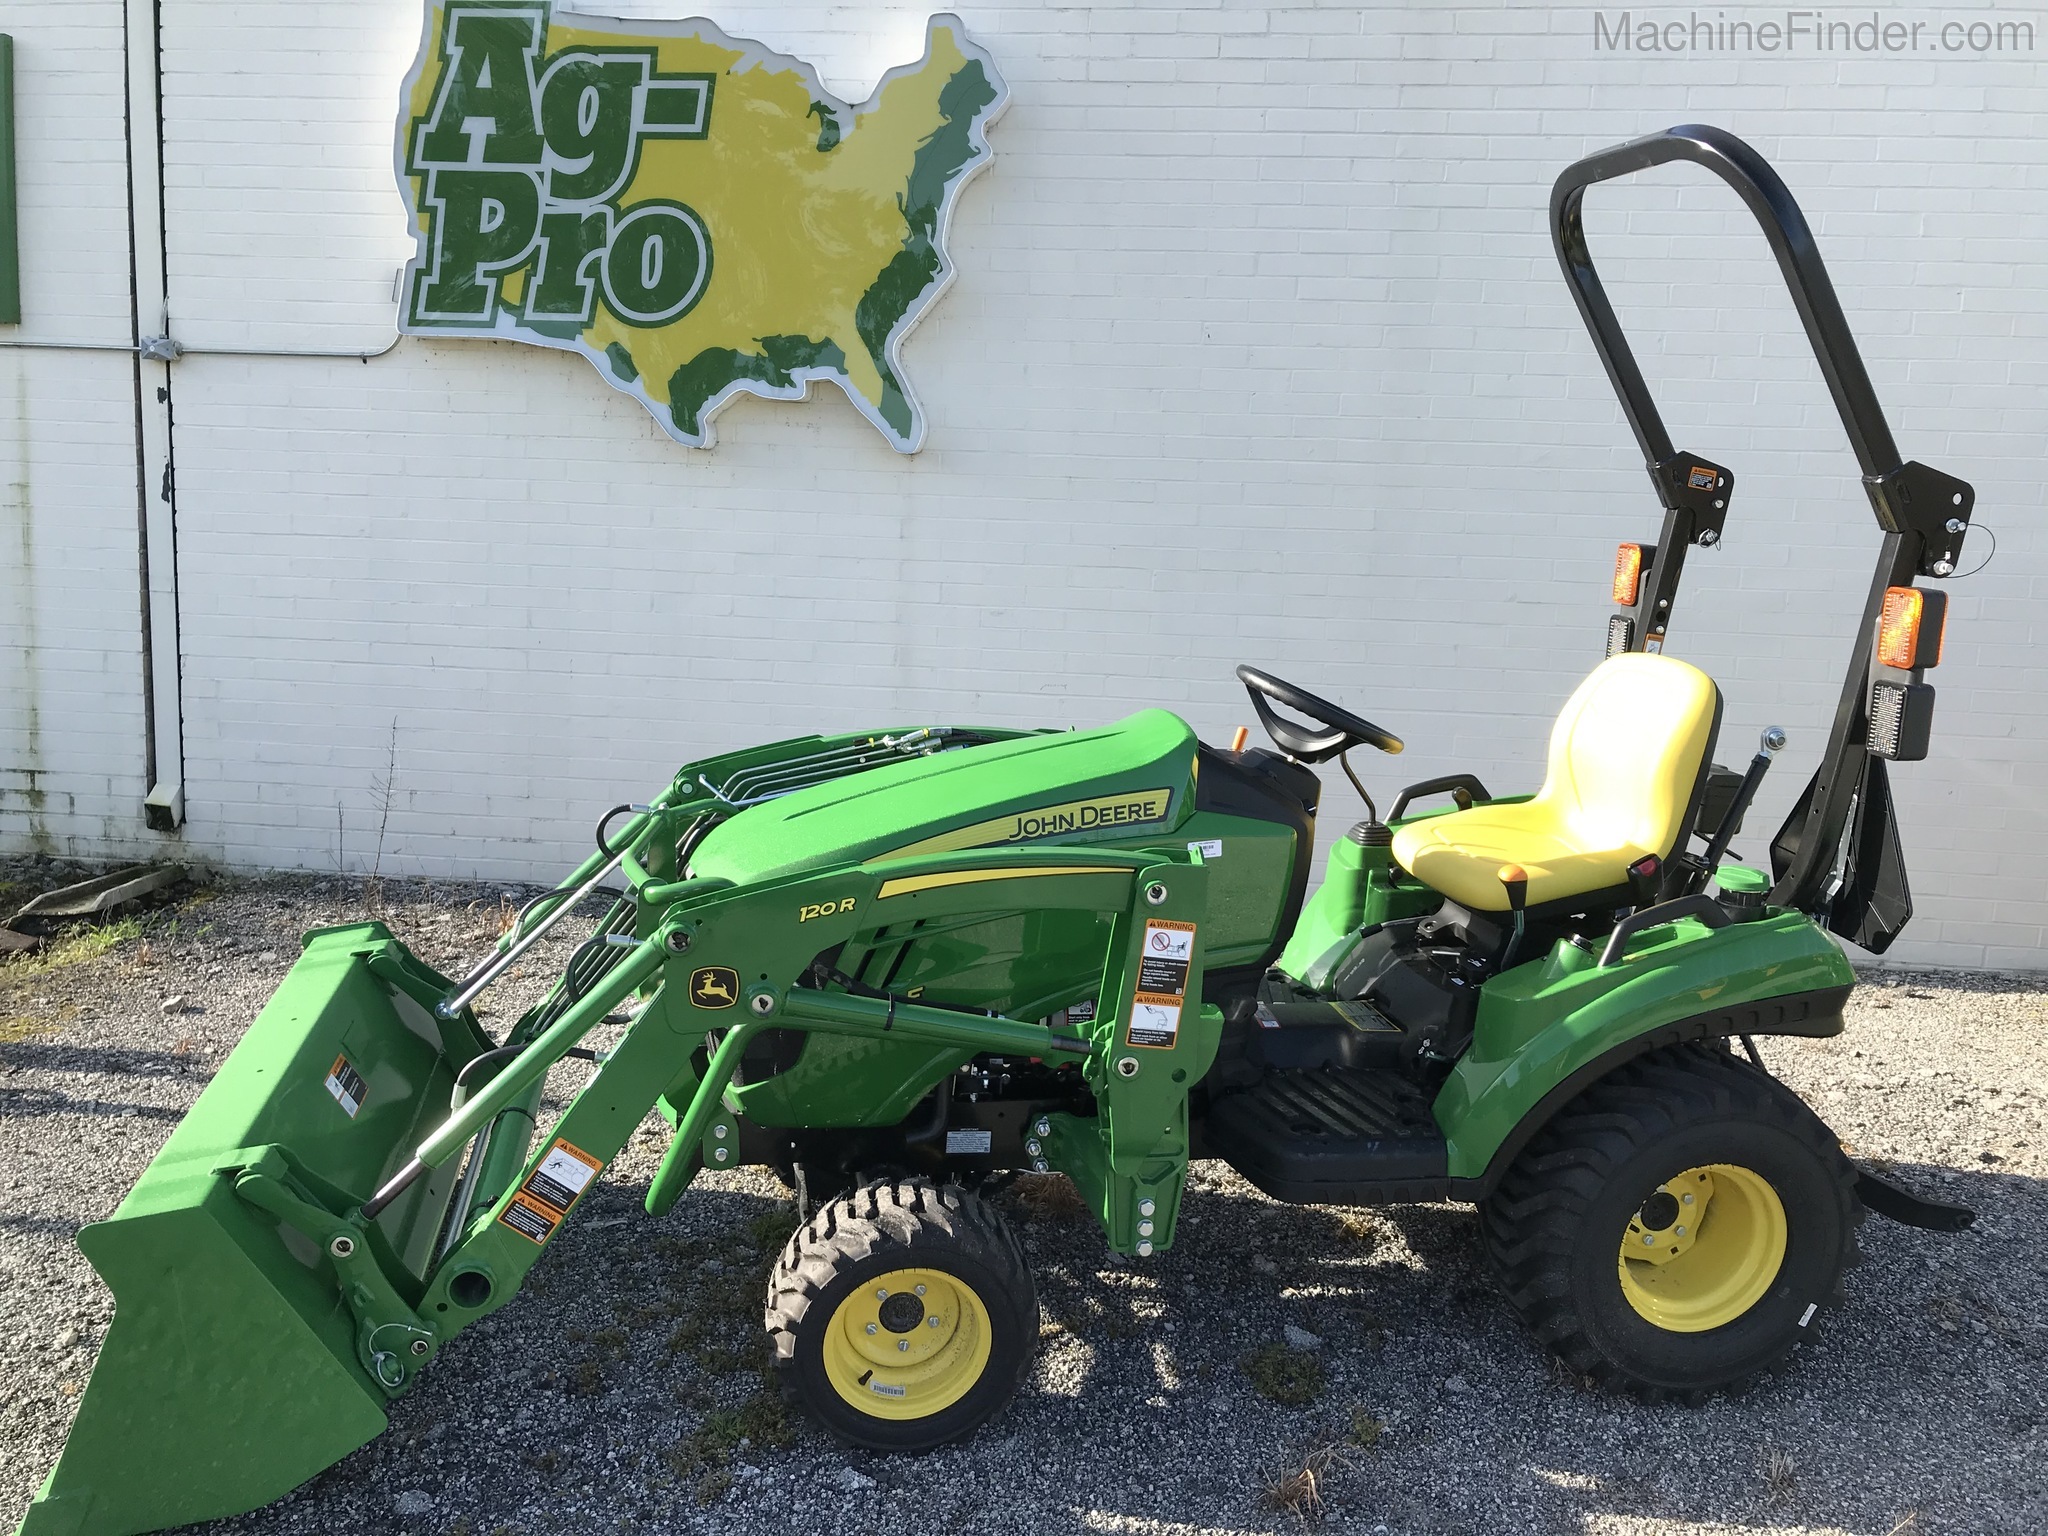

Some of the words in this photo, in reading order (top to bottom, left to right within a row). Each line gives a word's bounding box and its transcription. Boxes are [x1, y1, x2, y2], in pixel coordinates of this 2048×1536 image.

[408, 4, 714, 205] Ag-
[410, 169, 711, 326] Pro
[1009, 812, 1074, 839] JOHN
[1080, 801, 1157, 826] DEERE
[799, 901, 837, 923] 120
[839, 897, 856, 913] R
[1156, 920, 1194, 931] WARNING
[1143, 996, 1181, 1006] WARNING
[568, 1146, 597, 1167] WARNING
[527, 1200, 556, 1221] WARNING
